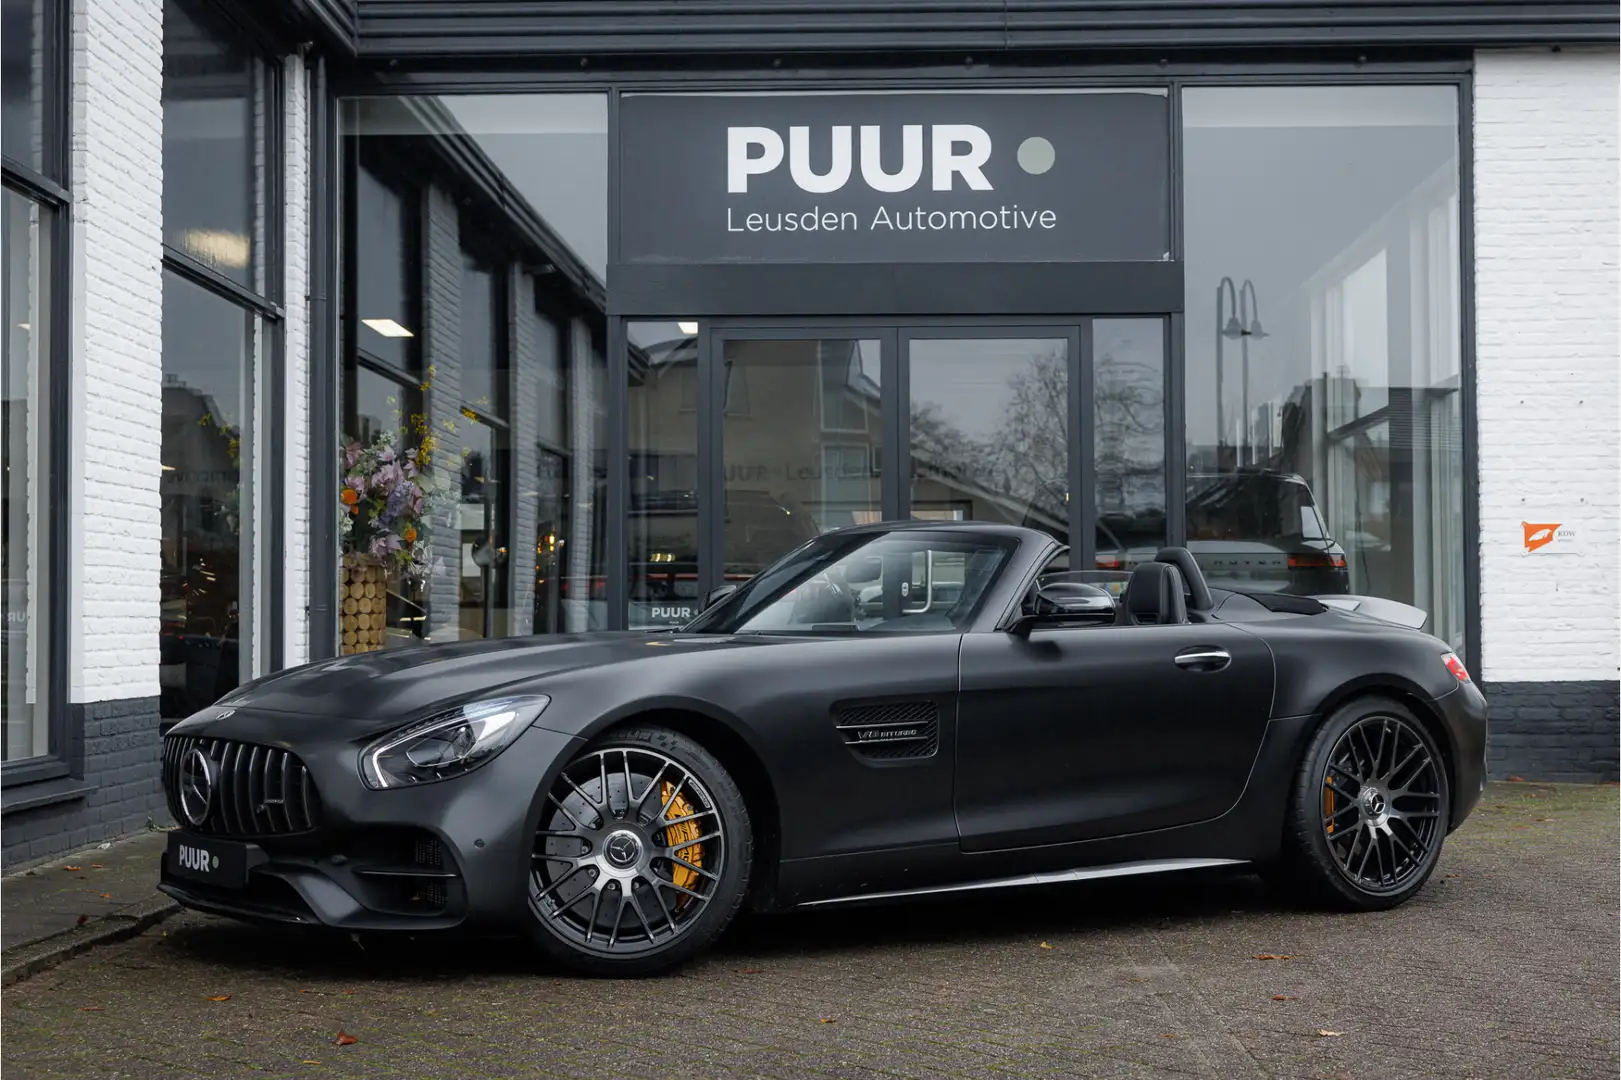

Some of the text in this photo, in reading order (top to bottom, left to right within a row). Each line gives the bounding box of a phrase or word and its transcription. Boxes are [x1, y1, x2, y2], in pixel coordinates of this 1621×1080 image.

[727, 124, 994, 194] PUUR
[727, 204, 1057, 232] Leusden Automotive
[651, 606, 691, 618] PUUR
[179, 844, 210, 873] PUUR
